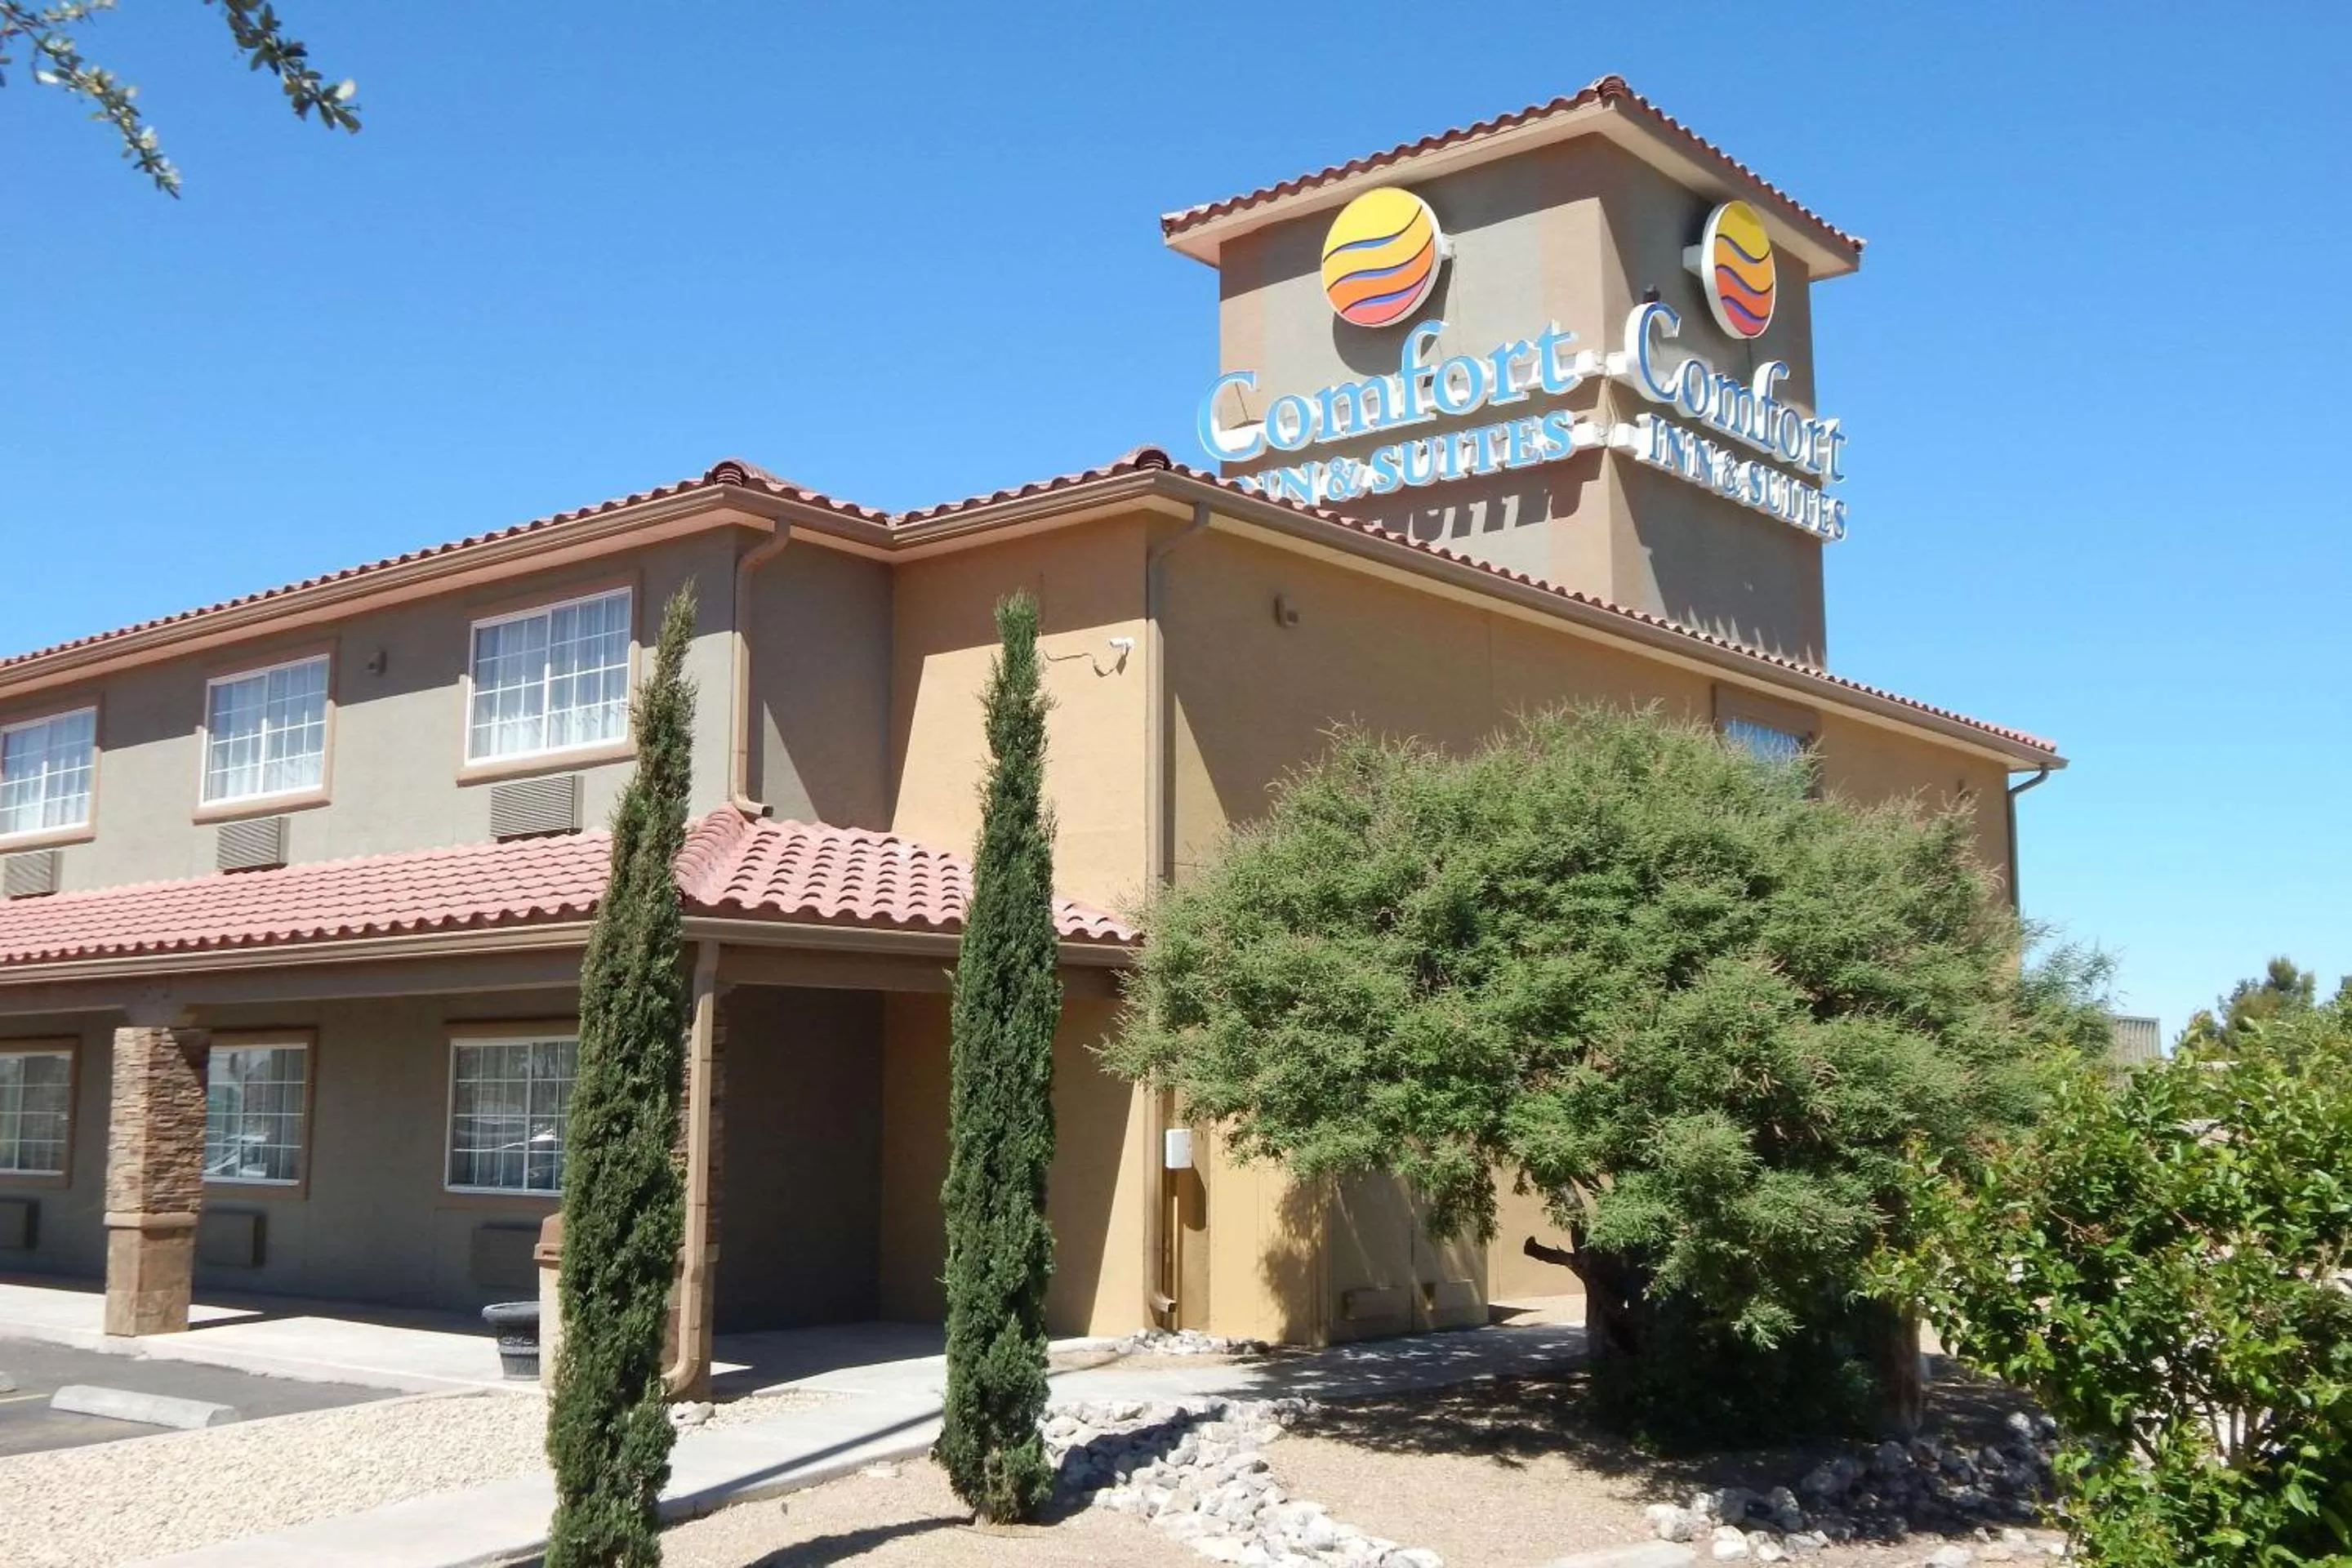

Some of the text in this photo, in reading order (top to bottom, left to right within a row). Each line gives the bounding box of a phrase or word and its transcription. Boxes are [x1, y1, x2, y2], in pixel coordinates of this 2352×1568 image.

[1197, 319, 1582, 462] Comfort
[1370, 410, 1576, 495] SUITES
[1626, 301, 1846, 483] Comfort
[1639, 414, 1717, 486] INN
[1740, 461, 1846, 542] SUITES
